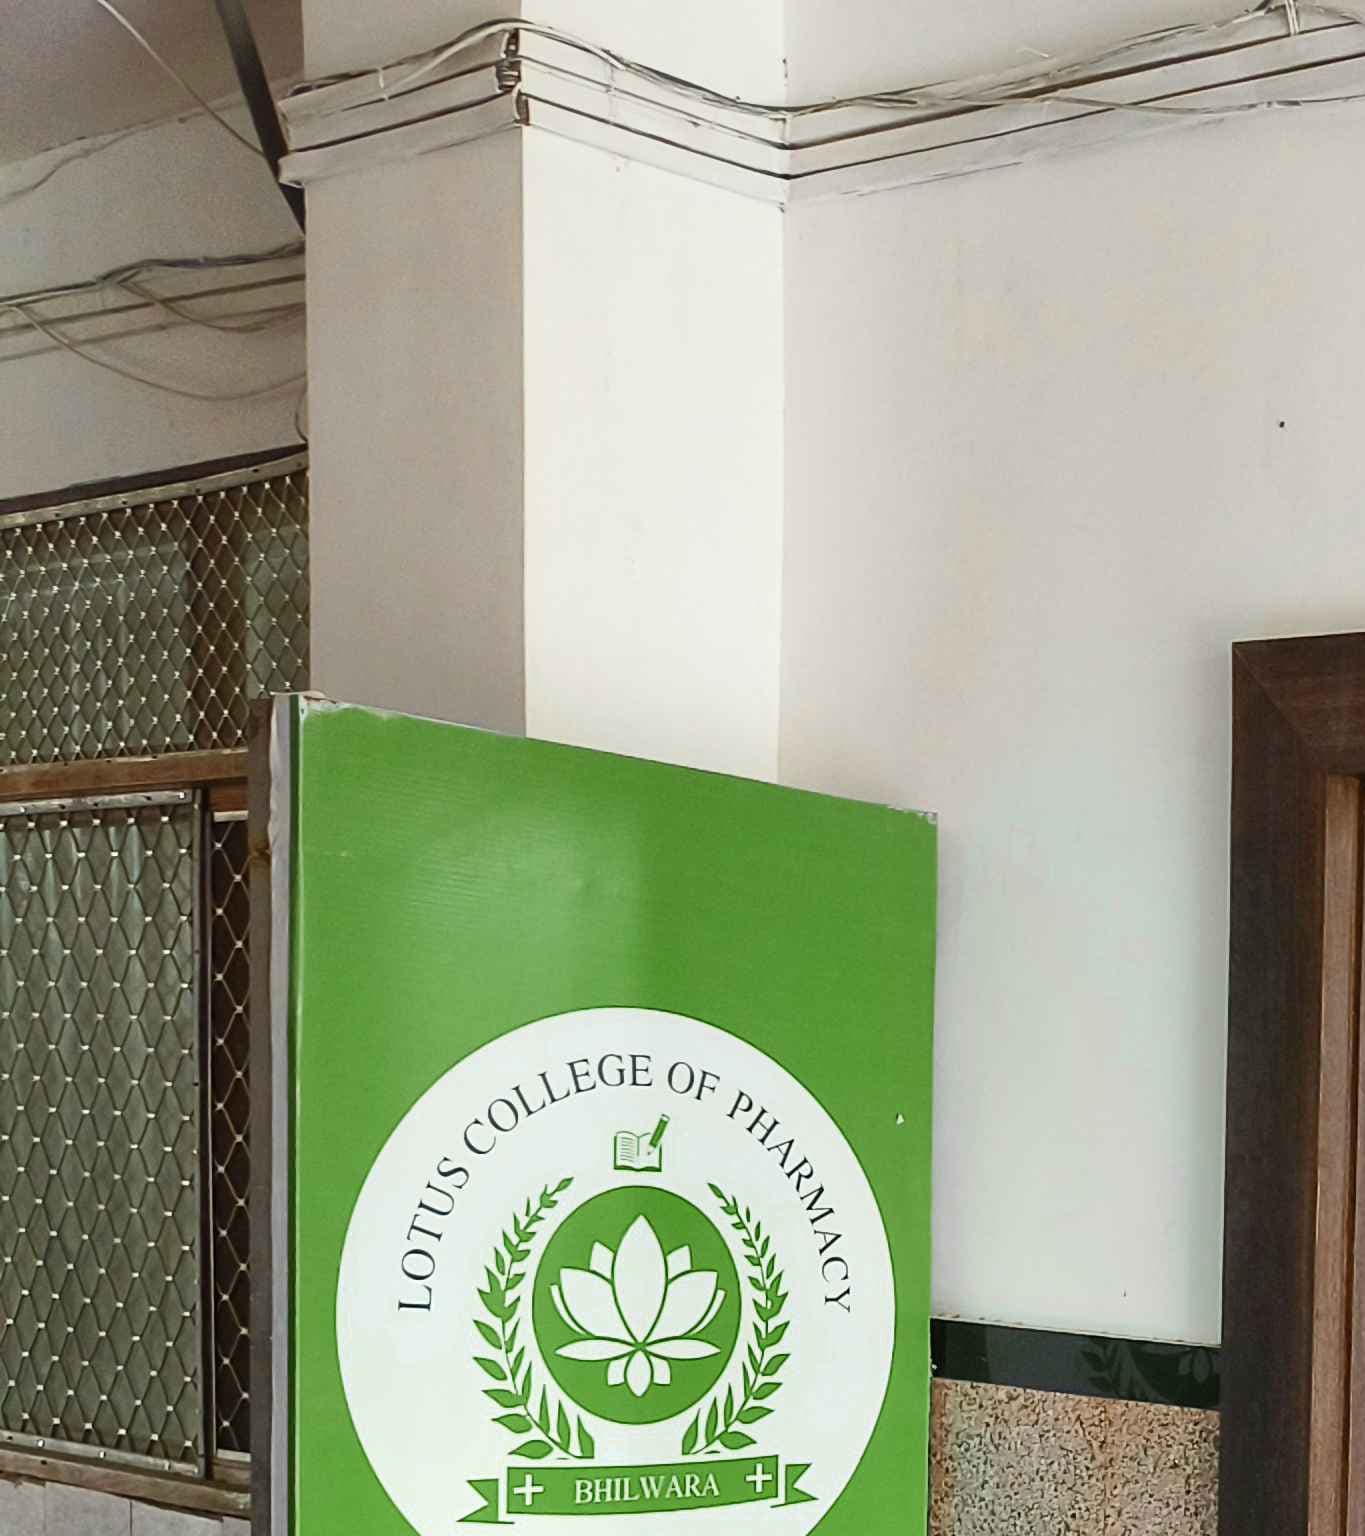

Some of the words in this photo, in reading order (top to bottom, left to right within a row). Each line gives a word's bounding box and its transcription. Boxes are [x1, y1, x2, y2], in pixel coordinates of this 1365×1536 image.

[398, 1156, 471, 1312] LOTUS
[463, 1053, 653, 1156] COLLEGE
[667, 1061, 721, 1101] OF
[727, 1089, 851, 1312] PHARMACY
[575, 1472, 720, 1504] BHILWARA
